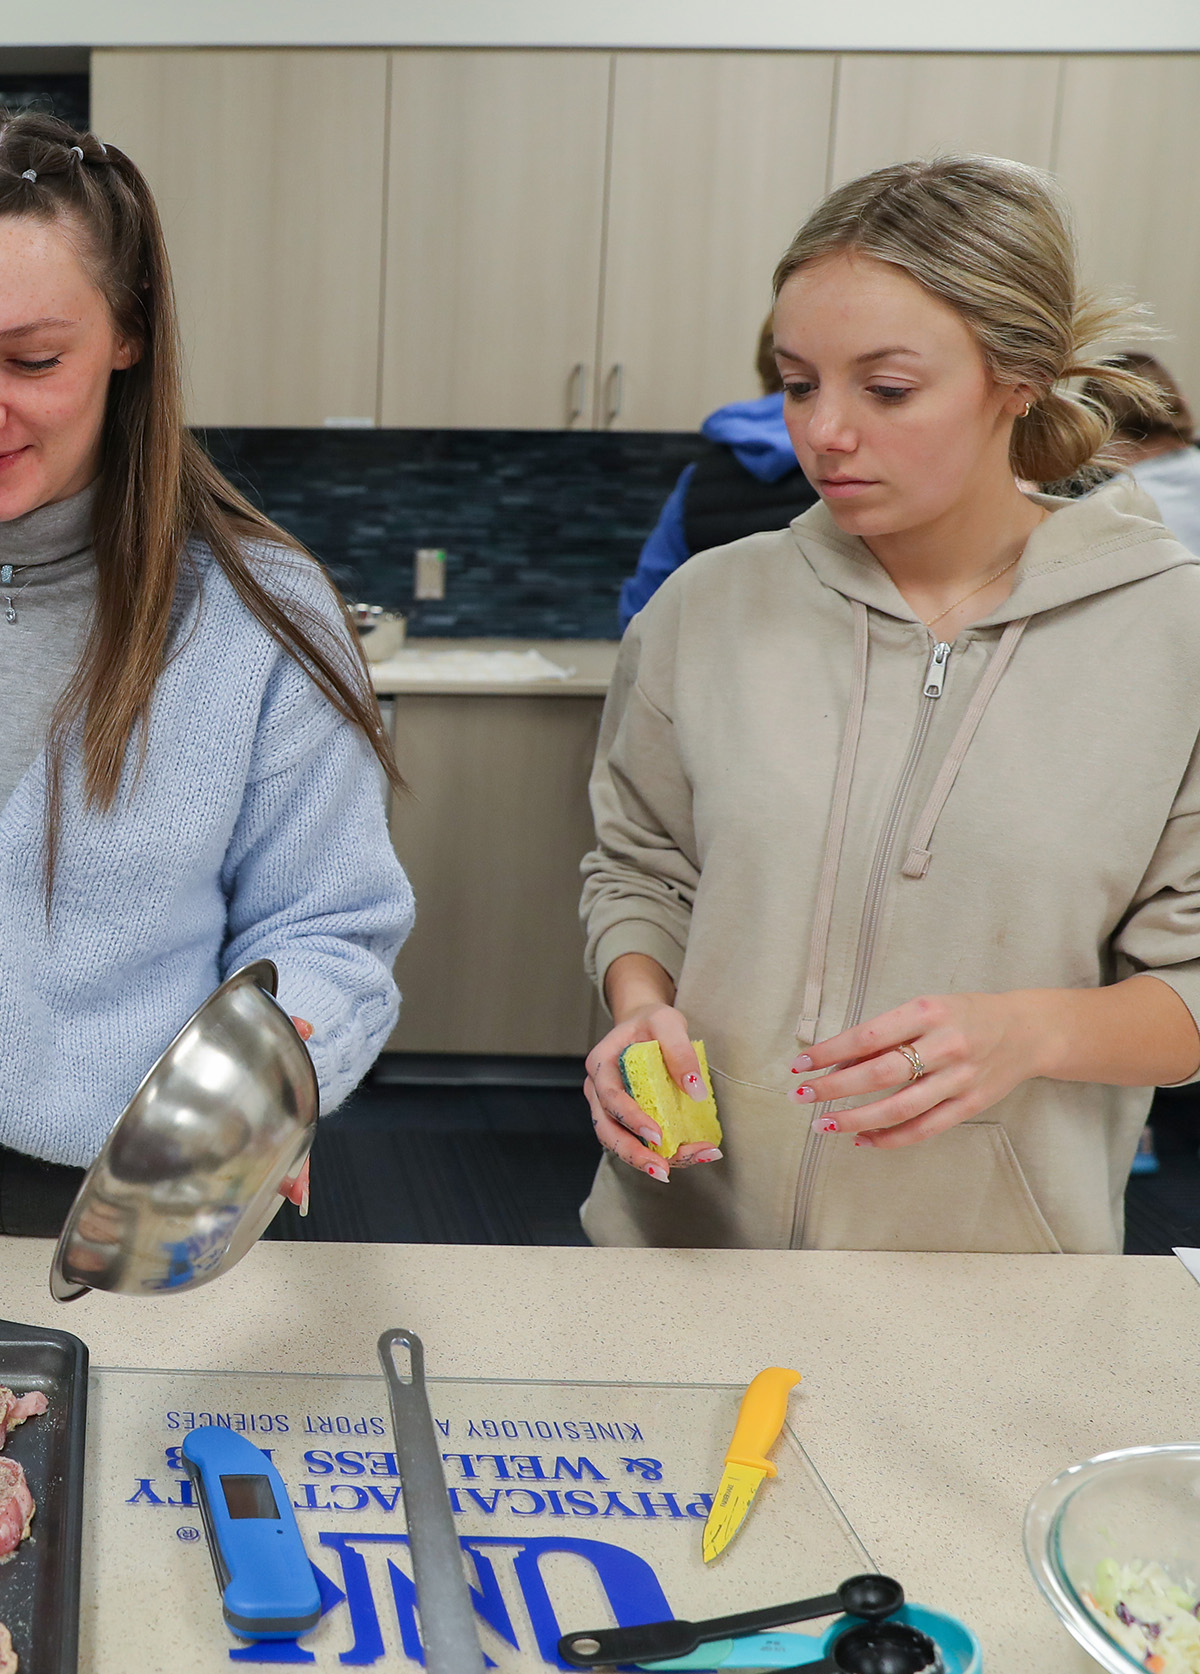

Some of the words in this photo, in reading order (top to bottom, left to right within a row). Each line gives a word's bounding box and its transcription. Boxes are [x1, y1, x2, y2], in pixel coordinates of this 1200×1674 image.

[166, 1411, 290, 1432] SCIENCES
[304, 1415, 386, 1436] SPORT
[468, 1419, 644, 1441] KINESIOLOGY
[303, 1450, 610, 1482] WELLESS
[620, 1456, 664, 1482] &
[125, 1479, 403, 1514] ACTTY
